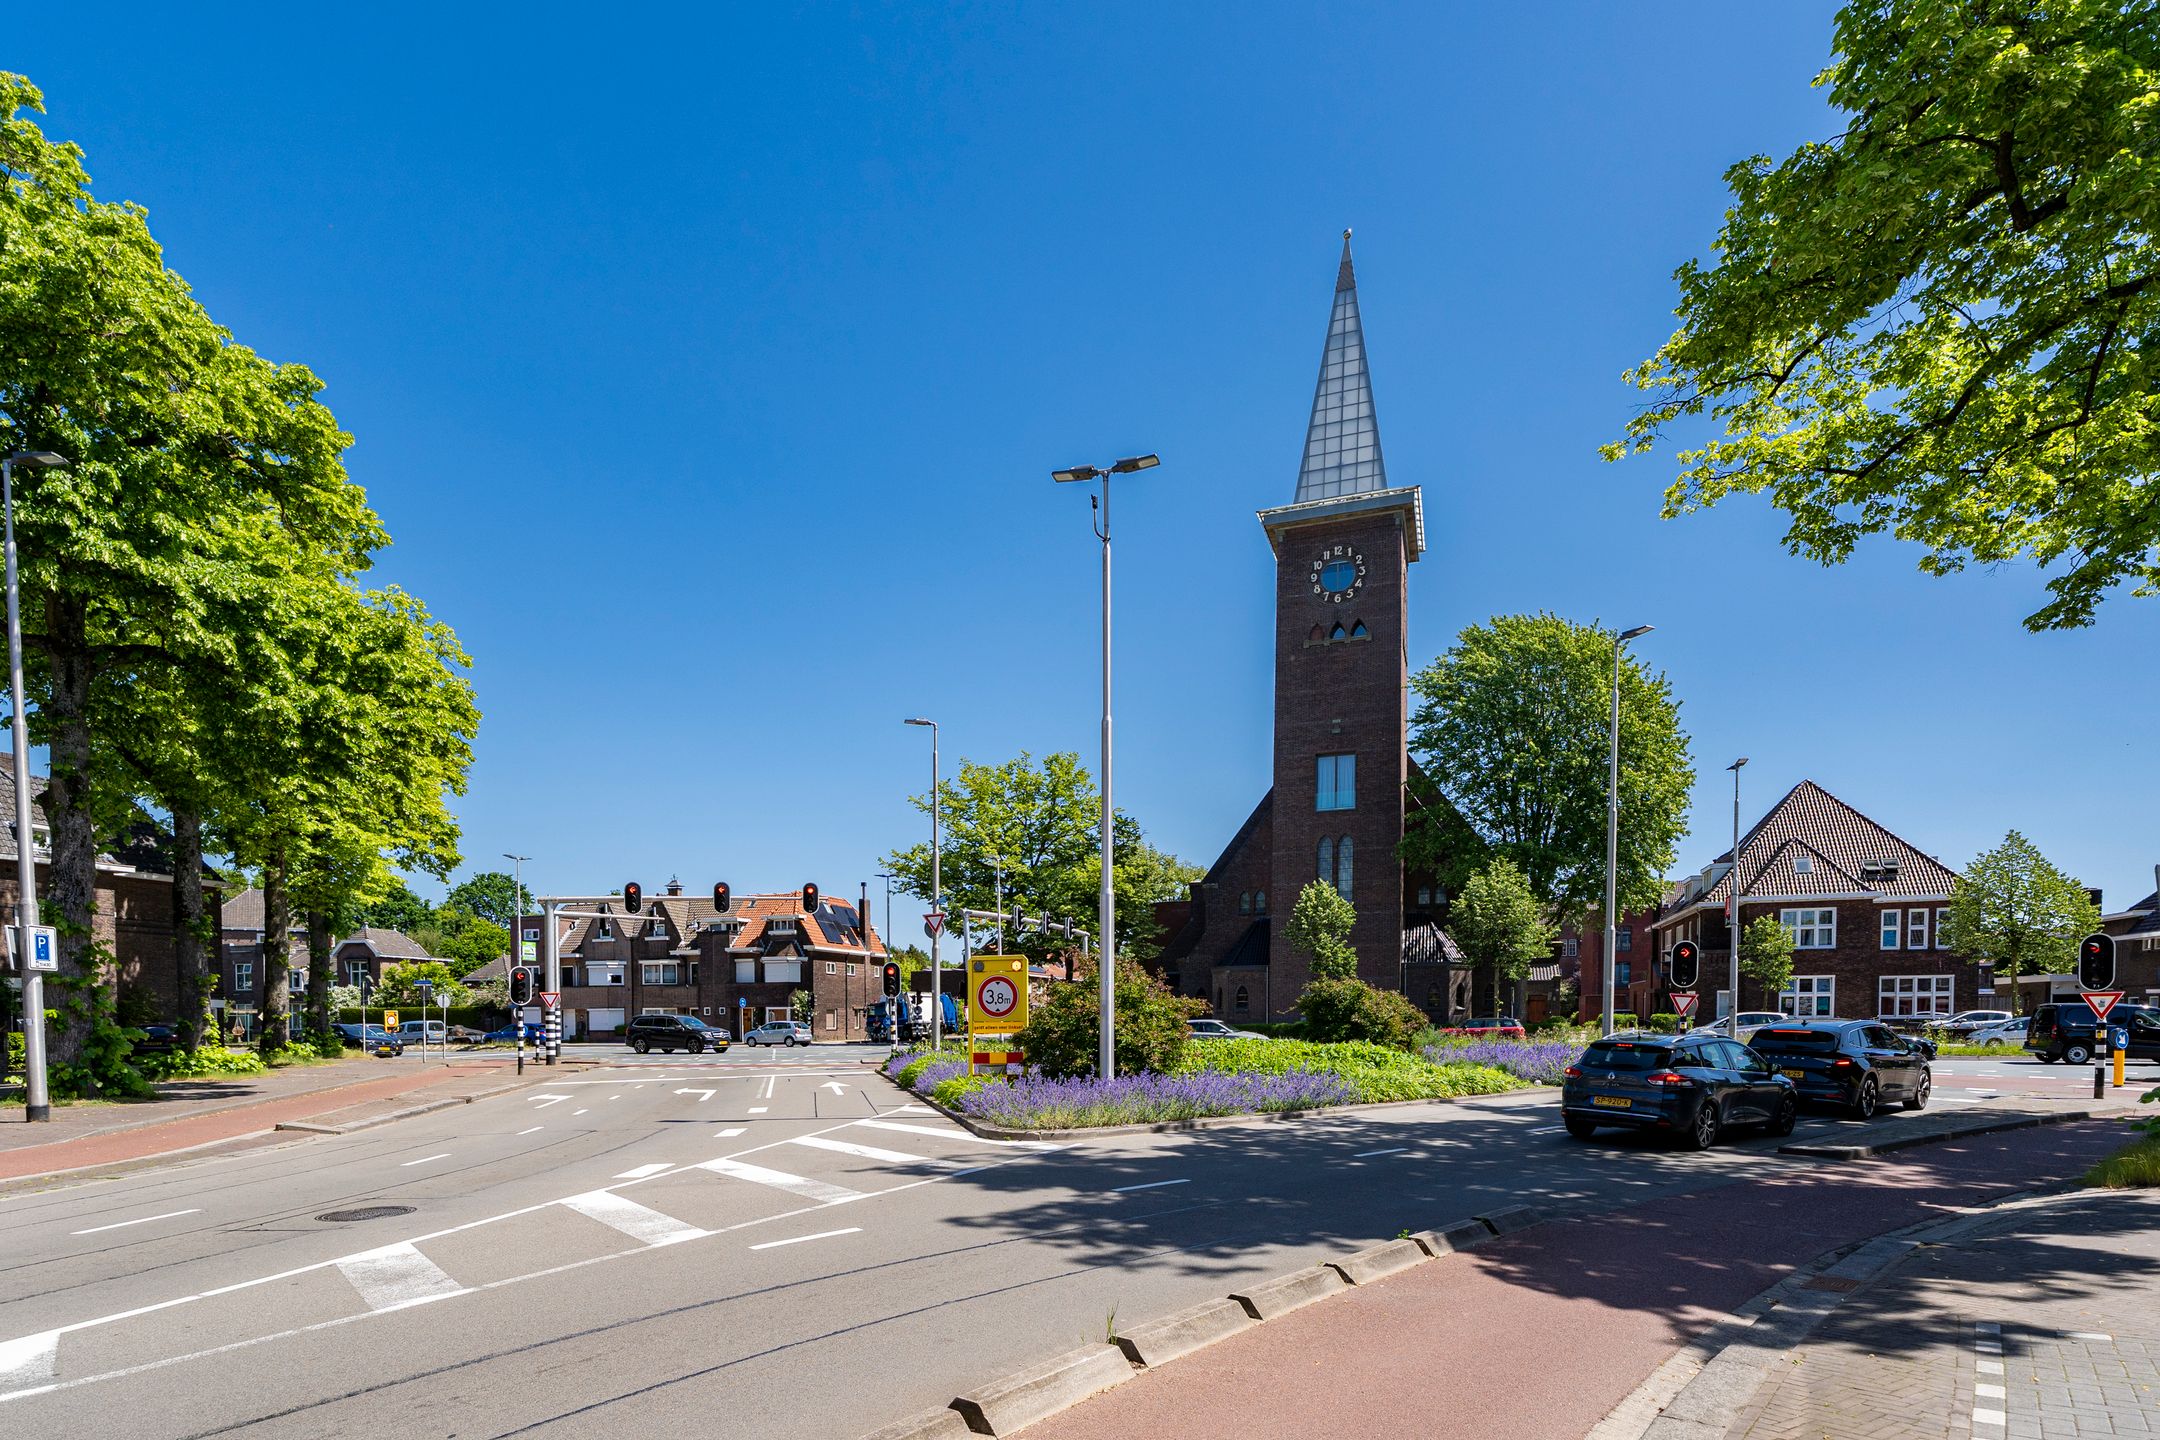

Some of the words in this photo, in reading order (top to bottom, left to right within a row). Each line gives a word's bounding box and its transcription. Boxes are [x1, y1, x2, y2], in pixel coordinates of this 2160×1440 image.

[1323, 550, 1330, 560] 11
[1334, 546, 1342, 555] 12
[1348, 547, 1352, 556] 1
[1356, 555, 1362, 564] 2
[1314, 560, 1322, 570] 10
[1358, 566, 1366, 576] 3
[1310, 574, 1318, 582] 9
[1354, 578, 1362, 588] 4
[1314, 584, 1320, 594] 8
[1346, 588, 1354, 598] 5
[1323, 592, 1330, 602] 7
[1334, 594, 1342, 603] 6
[38, 937, 46, 948] P
[986, 990, 1010, 1005] 3,8m
[1596, 1096, 1628, 1106] SP-920-K
